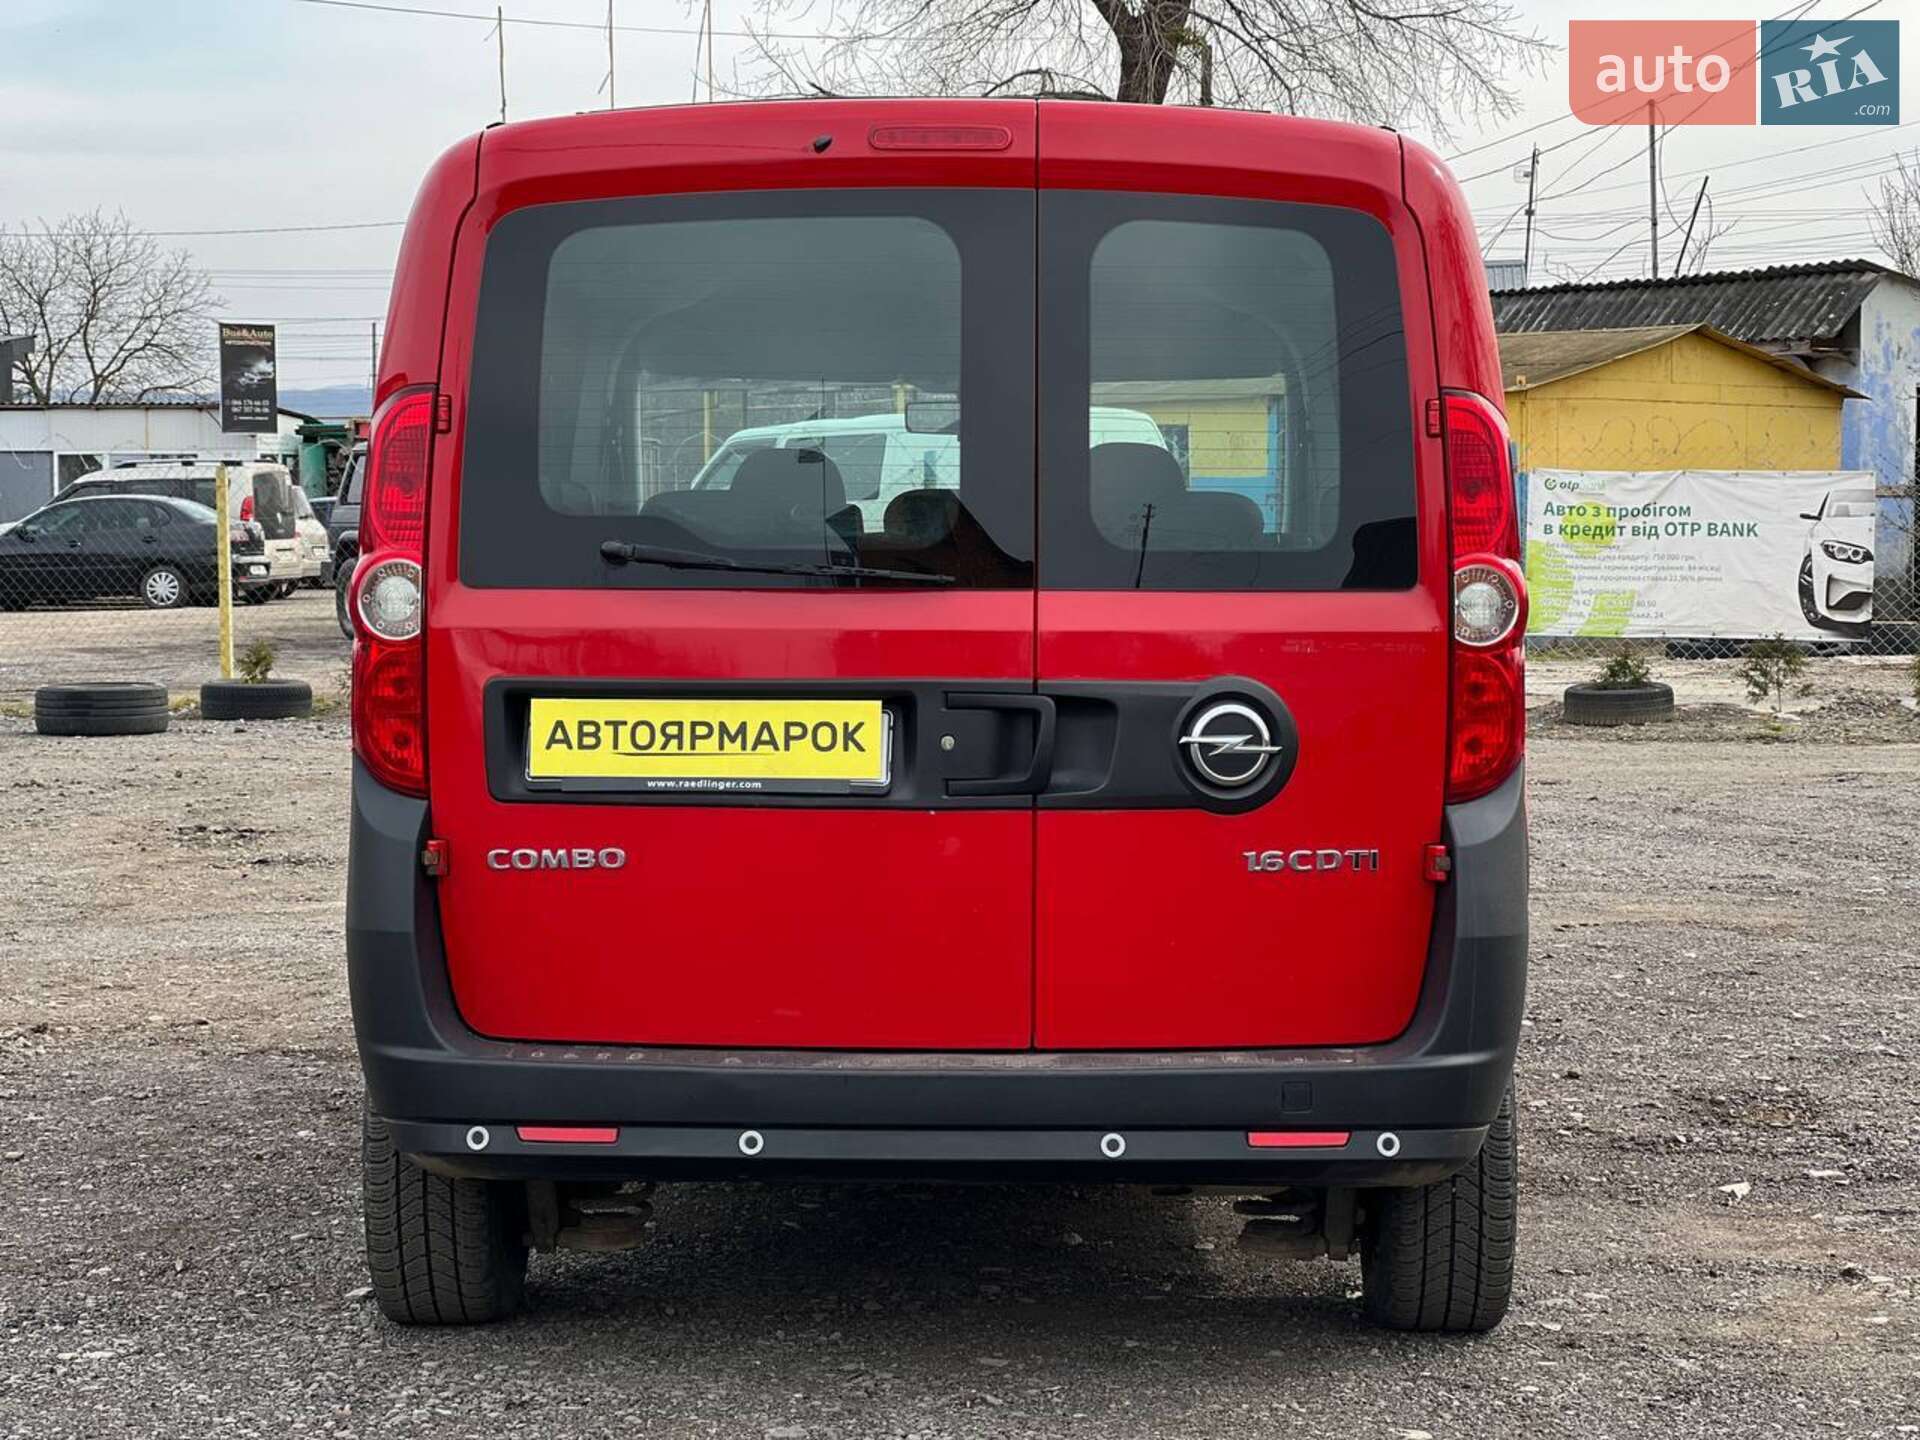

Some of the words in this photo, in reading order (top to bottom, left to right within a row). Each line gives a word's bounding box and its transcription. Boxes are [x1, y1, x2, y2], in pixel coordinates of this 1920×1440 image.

[1543, 501, 1587, 517] Авто
[1592, 505, 1601, 517] з
[1606, 502, 1692, 521] пробігом
[1543, 524, 1554, 535] в
[1558, 524, 1626, 539] кредит
[1631, 521, 1660, 539] від
[1664, 522, 1701, 537] OTP
[1707, 523, 1759, 538] BANK
[545, 719, 867, 753] АВТОЯРМАРОК
[647, 779, 762, 790] www.raedlinger.com
[486, 847, 626, 871] COMBO
